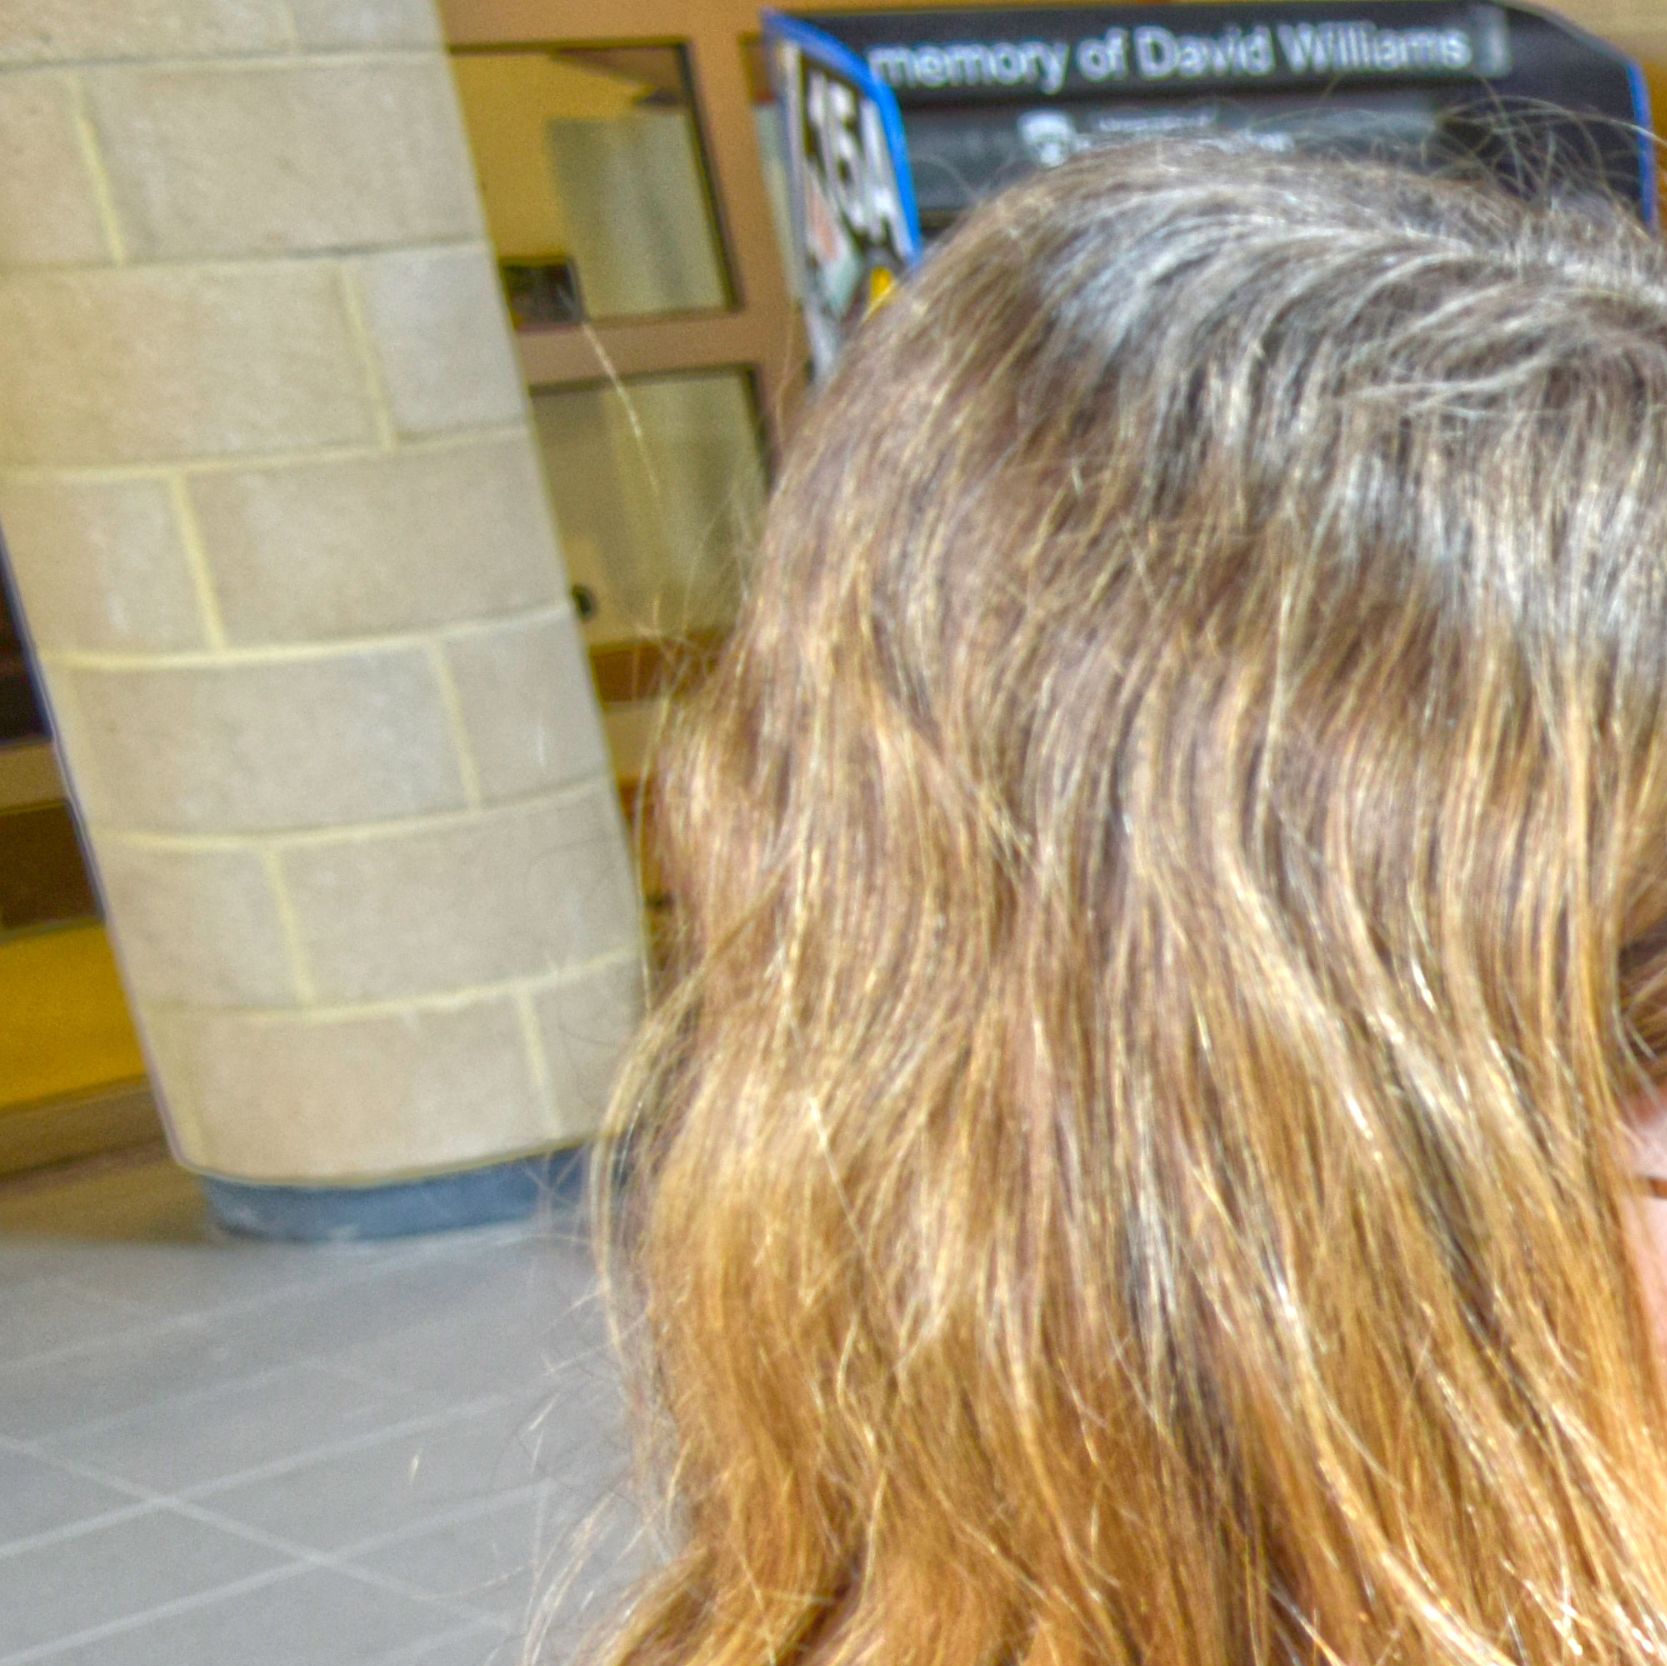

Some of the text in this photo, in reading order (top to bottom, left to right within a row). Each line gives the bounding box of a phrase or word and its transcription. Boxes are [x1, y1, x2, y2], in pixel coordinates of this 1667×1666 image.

[868, 20, 1472, 94] memory of David Williams
